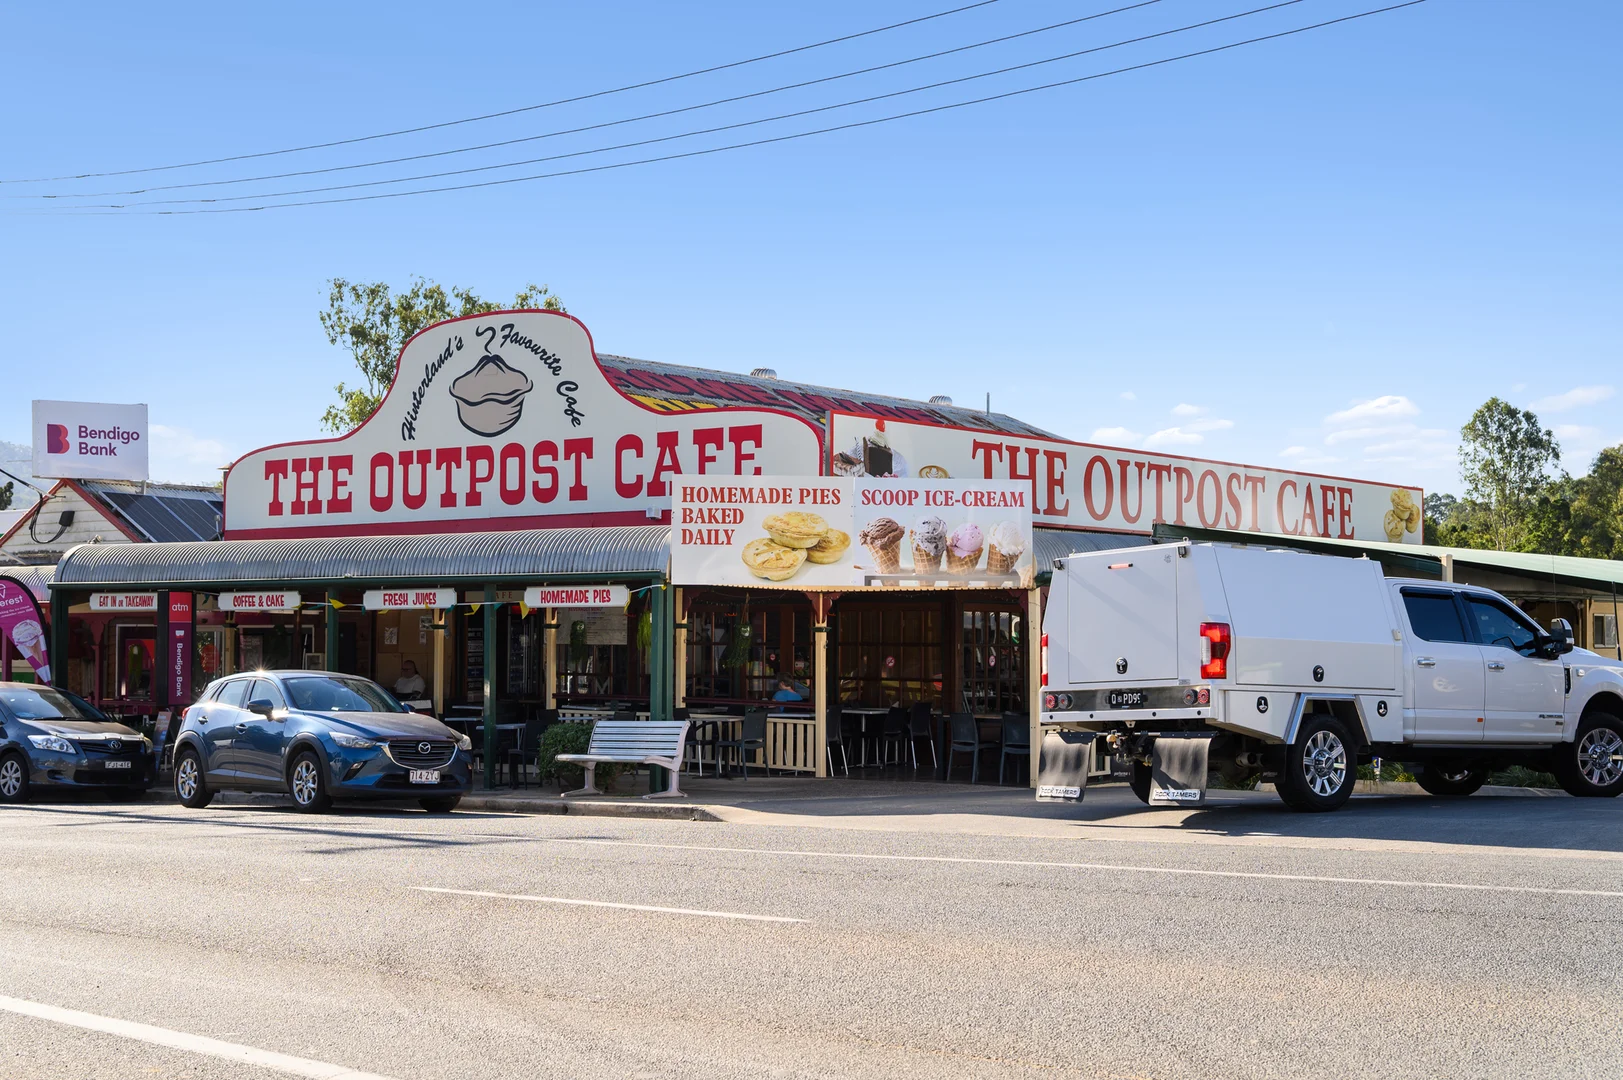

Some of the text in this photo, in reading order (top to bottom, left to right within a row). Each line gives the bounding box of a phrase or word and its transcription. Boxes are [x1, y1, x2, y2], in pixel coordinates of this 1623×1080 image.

[402, 323, 585, 441] Hinterland's Favourite Cafe
[78, 425, 140, 444] Bendigo
[78, 441, 117, 456] Bank
[264, 424, 763, 516] THE OUTPOST CAFE
[681, 486, 841, 505] HOMEMADE PIES
[861, 488, 1025, 508] SCOOP ICE-CREAM
[971, 438, 1354, 540] THE OUTPOST CAFE
[681, 507, 744, 525] BAKED
[681, 528, 735, 546] DAILY
[99, 595, 109, 607] EAT
[110, 595, 117, 607] IN
[125, 595, 154, 607] TAKEAWAY
[233, 594, 285, 607] COFFEE & CAKE
[383, 592, 437, 606] FRESH JUICES
[495, 591, 513, 599] AFE
[540, 589, 611, 603] HOMEMADE PIES
[172, 603, 188, 611] atm
[175, 643, 183, 675] Bendigo
